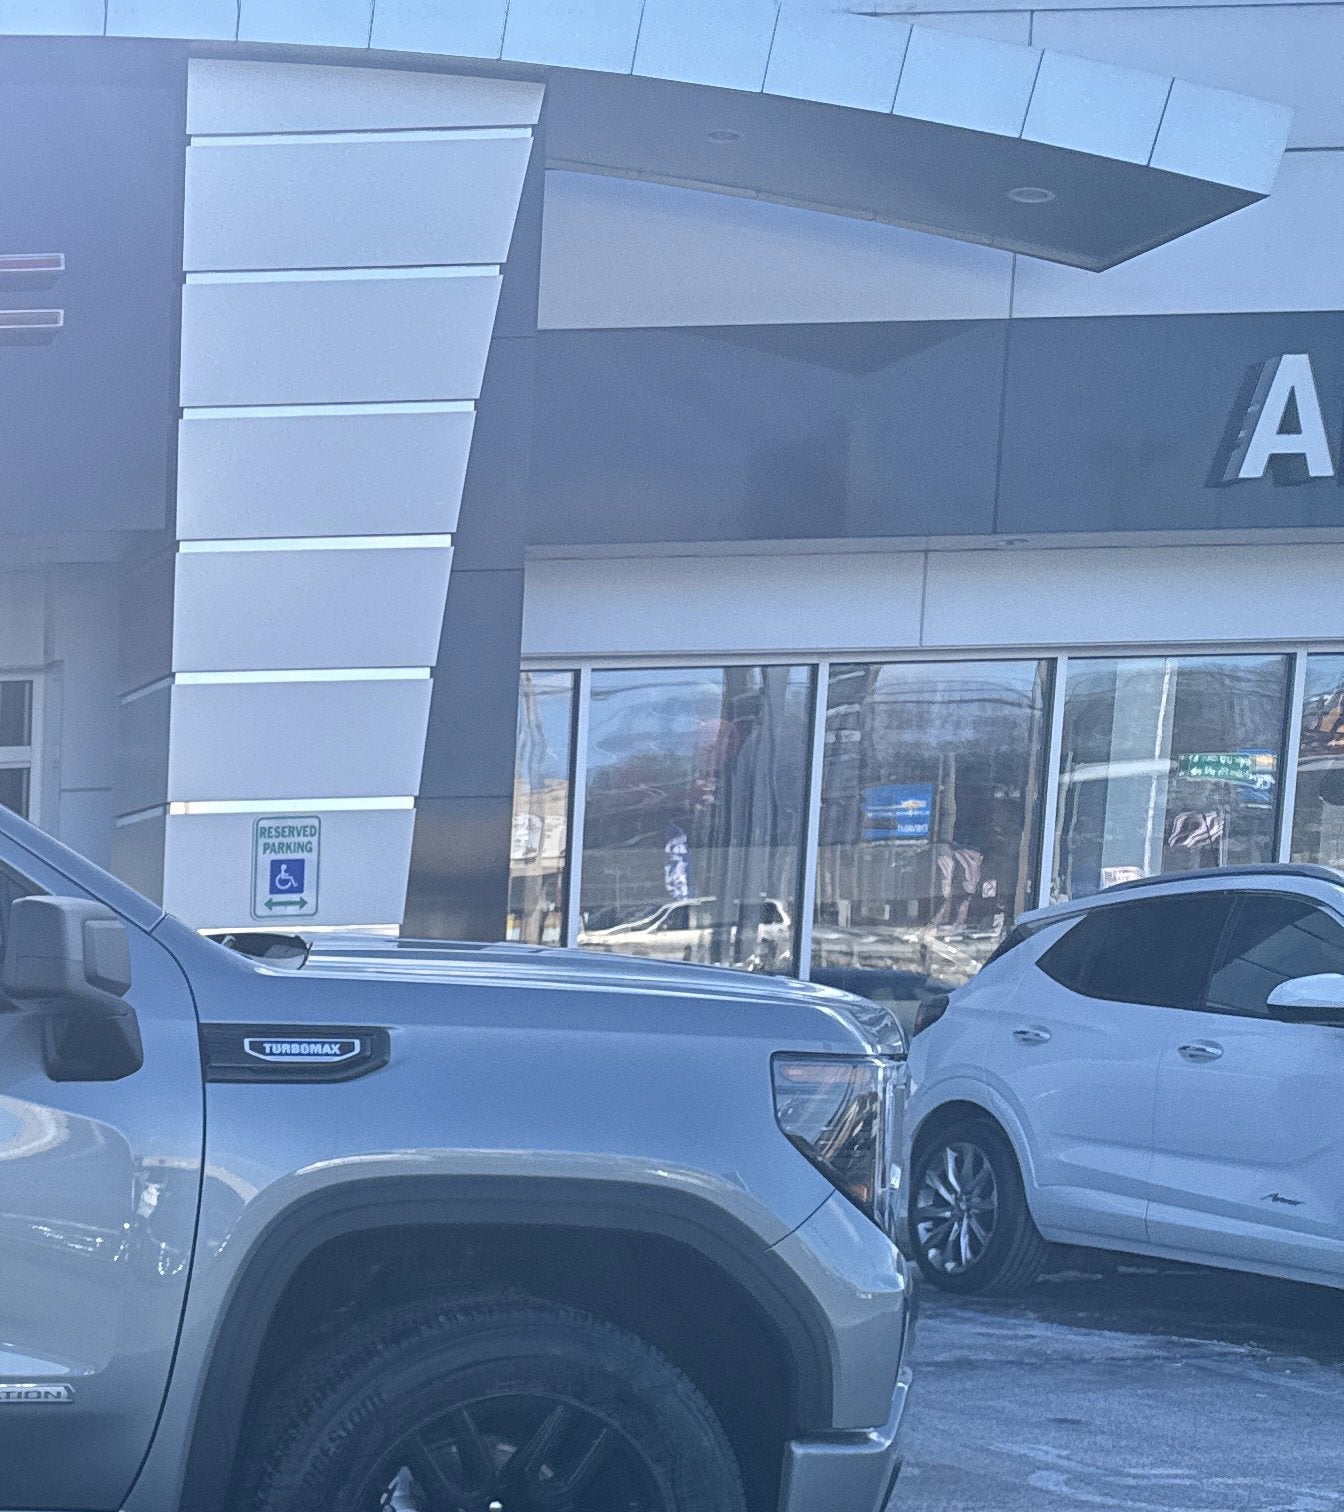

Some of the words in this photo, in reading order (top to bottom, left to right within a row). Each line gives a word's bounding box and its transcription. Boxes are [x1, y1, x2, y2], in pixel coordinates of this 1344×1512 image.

[259, 824, 318, 839] RESERVED
[262, 841, 314, 855] PARKING
[262, 1042, 341, 1056] TURBOMAX
